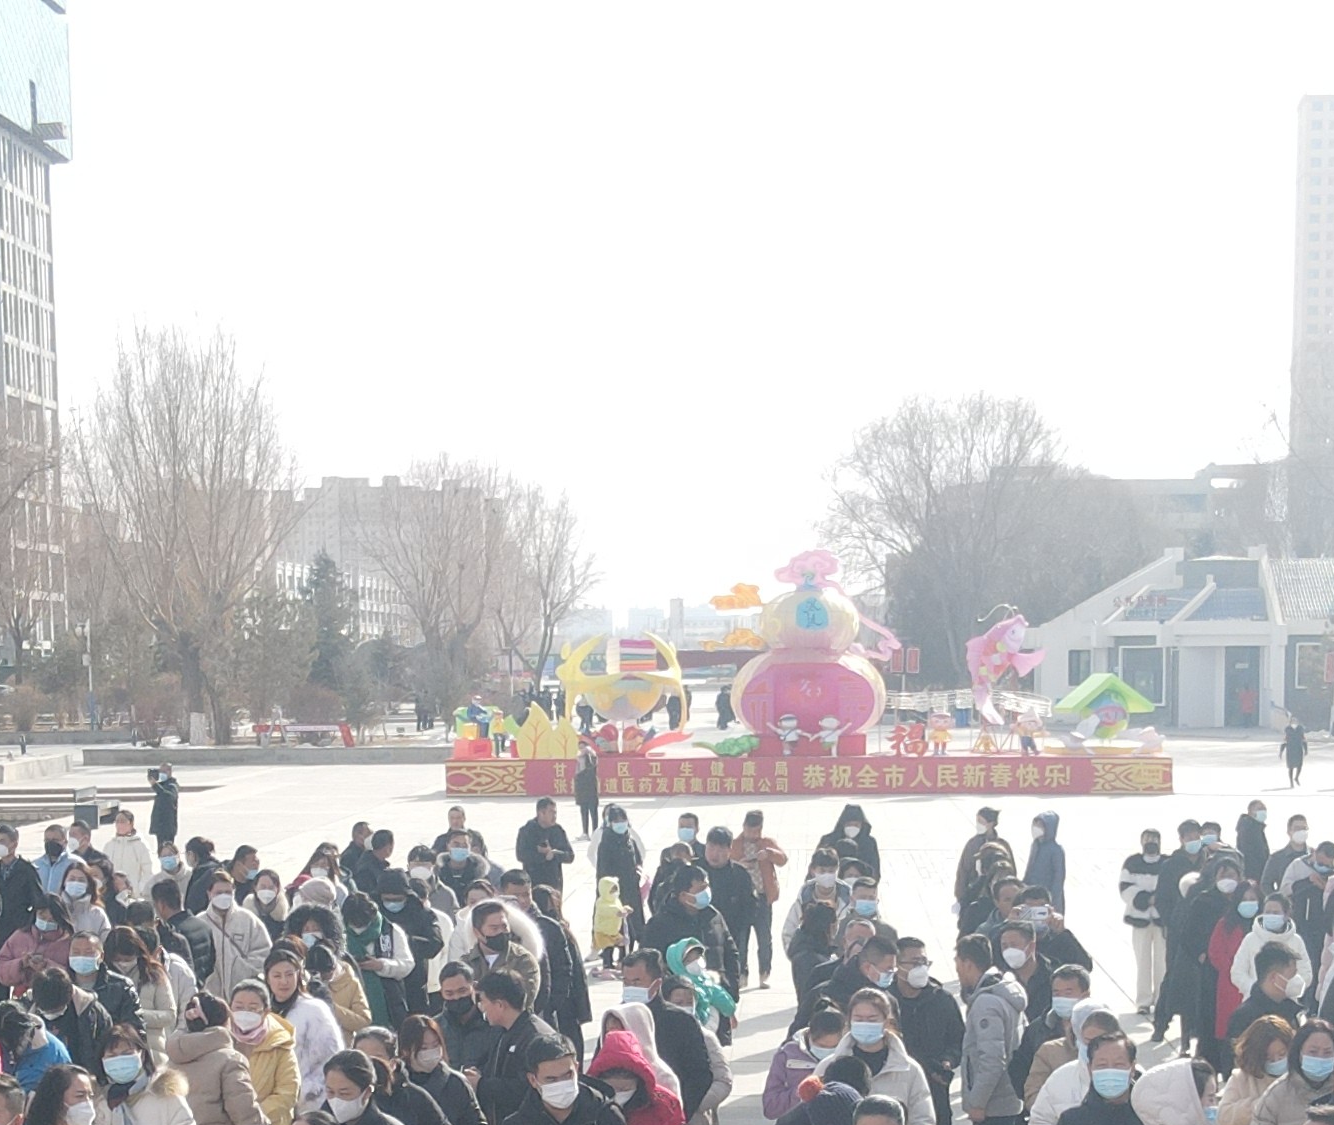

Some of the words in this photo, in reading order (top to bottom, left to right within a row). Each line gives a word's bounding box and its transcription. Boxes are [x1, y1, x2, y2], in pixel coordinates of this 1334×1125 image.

[553, 761, 788, 777] 甘区卫生健康局
[553, 777, 788, 794] 张道医药发展集团有限公司
